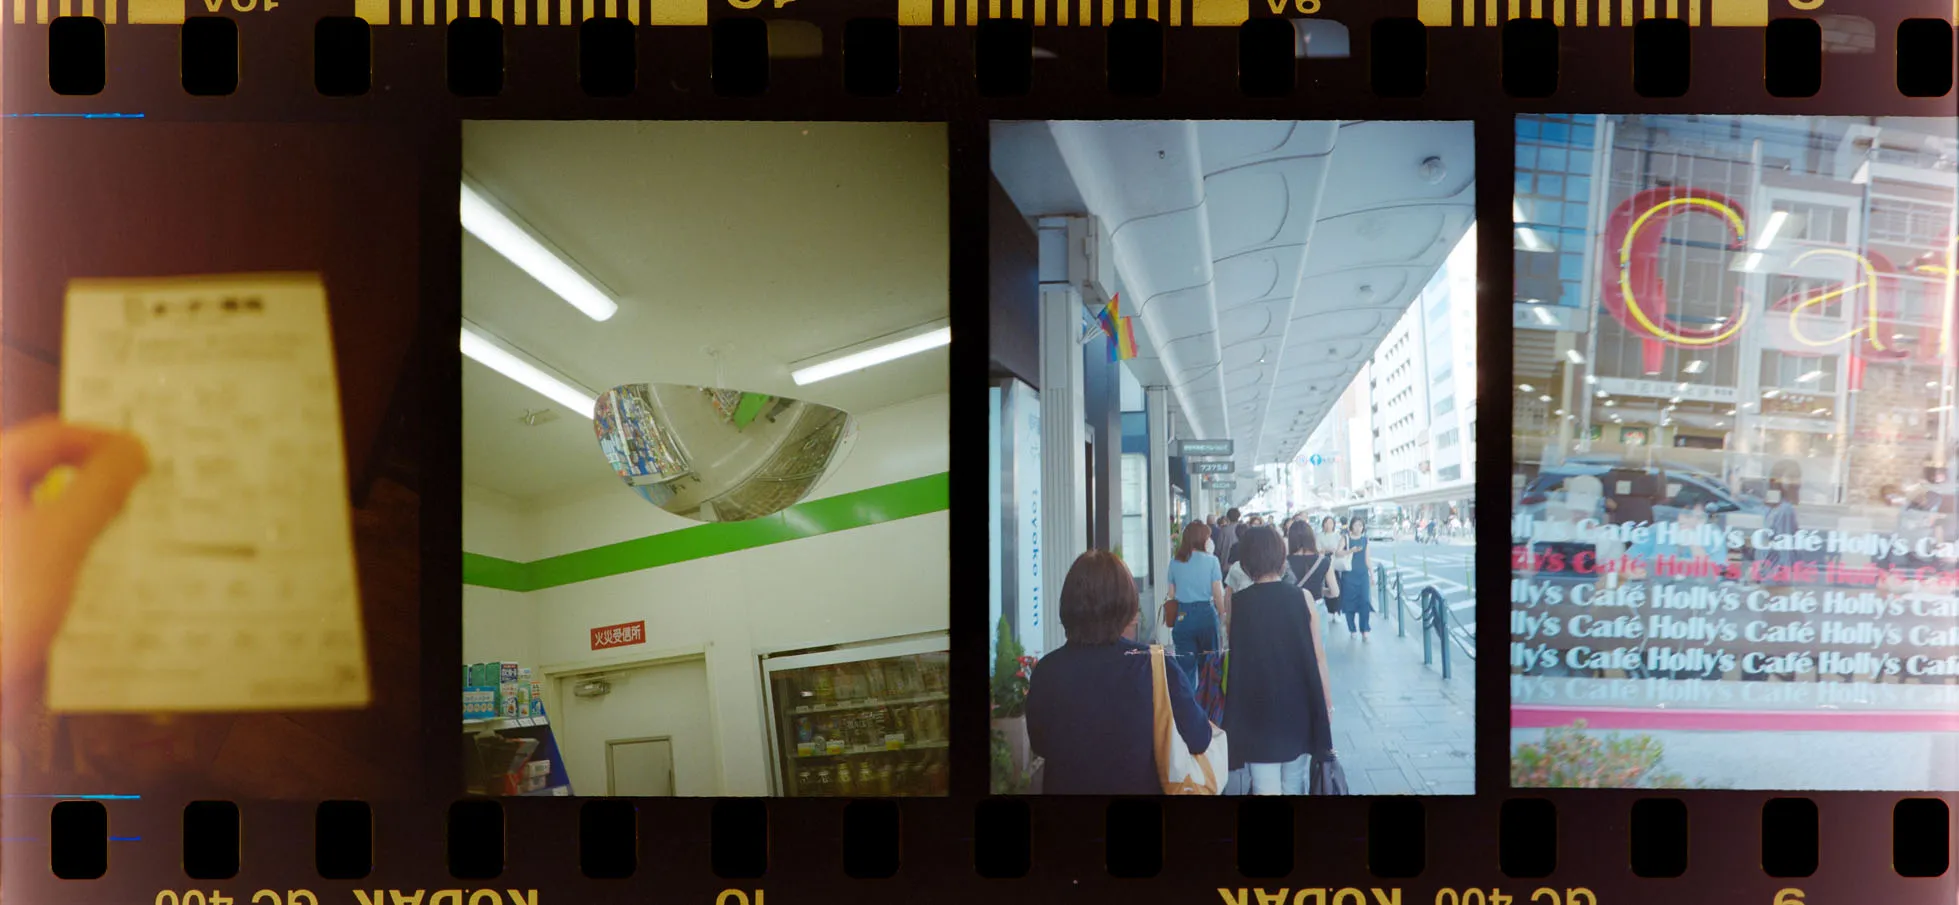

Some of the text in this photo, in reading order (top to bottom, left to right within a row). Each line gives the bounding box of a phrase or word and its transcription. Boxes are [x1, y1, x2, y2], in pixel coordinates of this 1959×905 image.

[1577, 518, 1649, 543] Café
[1656, 520, 1745, 552] Holly's
[1751, 528, 1823, 552] Café
[1827, 530, 1914, 560] Holly's
[1031, 586, 1040, 627] inn
[1570, 583, 1646, 607] Café
[1652, 584, 1740, 615] Holly's
[1747, 589, 1818, 613] Café
[1822, 591, 1905, 620] Holly's
[594, 624, 641, 647] 火災受信所
[1568, 614, 1644, 639] Café
[1650, 615, 1738, 646] Holly's
[1744, 620, 1816, 644] Café
[1820, 620, 1903, 649] Holly's
[1566, 646, 1642, 670] Café
[1647, 647, 1736, 677] Holly's
[1742, 651, 1814, 675] Café
[1818, 651, 1901, 679] Holly's
[1564, 676, 1640, 701] Café
